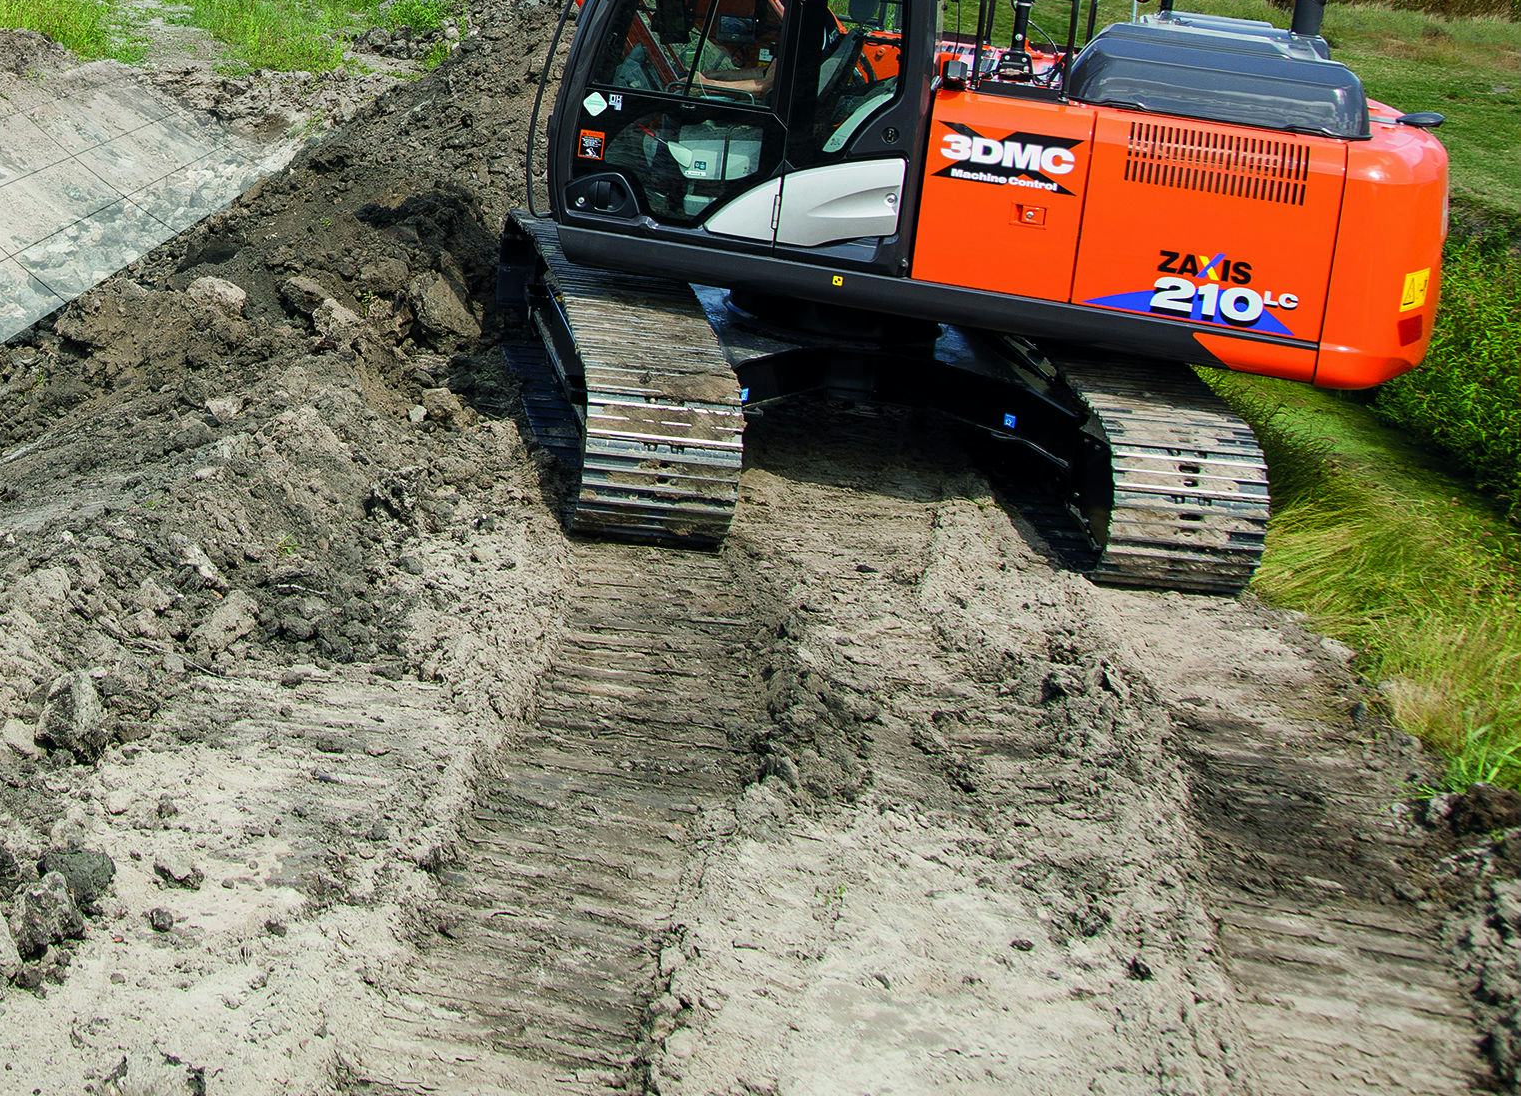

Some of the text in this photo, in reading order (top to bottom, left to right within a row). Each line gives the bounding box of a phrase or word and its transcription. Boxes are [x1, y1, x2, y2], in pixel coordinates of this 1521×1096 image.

[940, 133, 1076, 175] 3DMC
[950, 168, 1058, 192] Machine Control
[1157, 249, 1253, 285] ZAXIS
